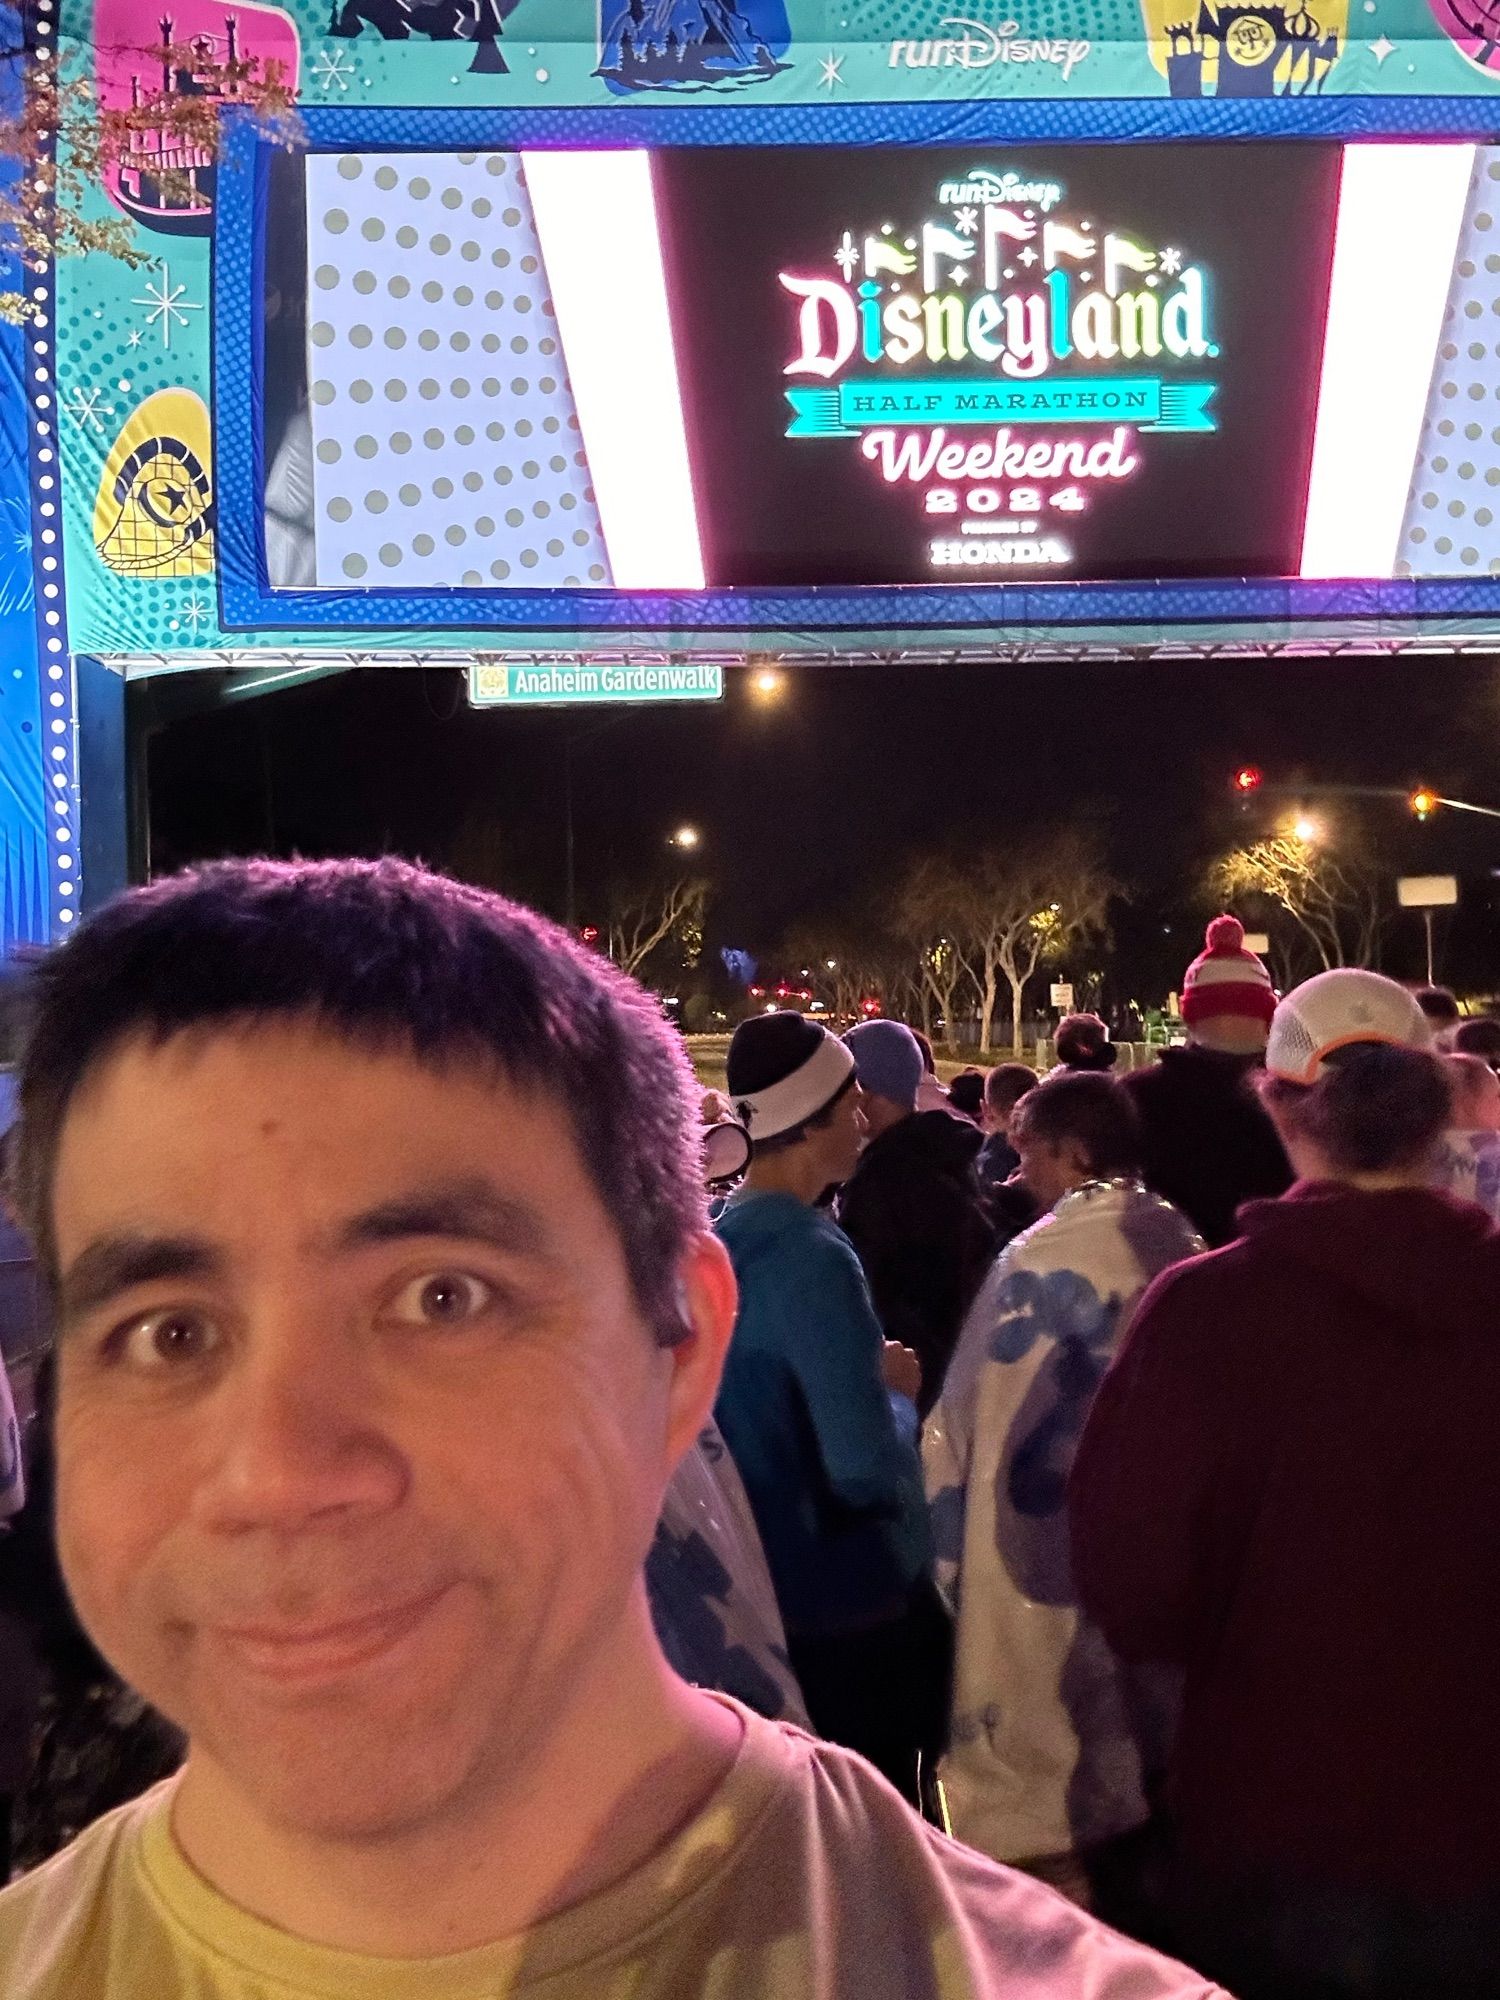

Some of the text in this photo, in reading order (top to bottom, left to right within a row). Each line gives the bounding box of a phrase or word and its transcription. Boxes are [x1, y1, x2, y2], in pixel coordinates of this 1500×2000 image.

[852, 391, 1149, 413] HALF MARATHON
[861, 427, 1138, 483] Weekend
[925, 486, 1086, 513] 2024
[930, 540, 1071, 566] HONDA
[514, 665, 717, 694] Anaheim Gardenwalk
